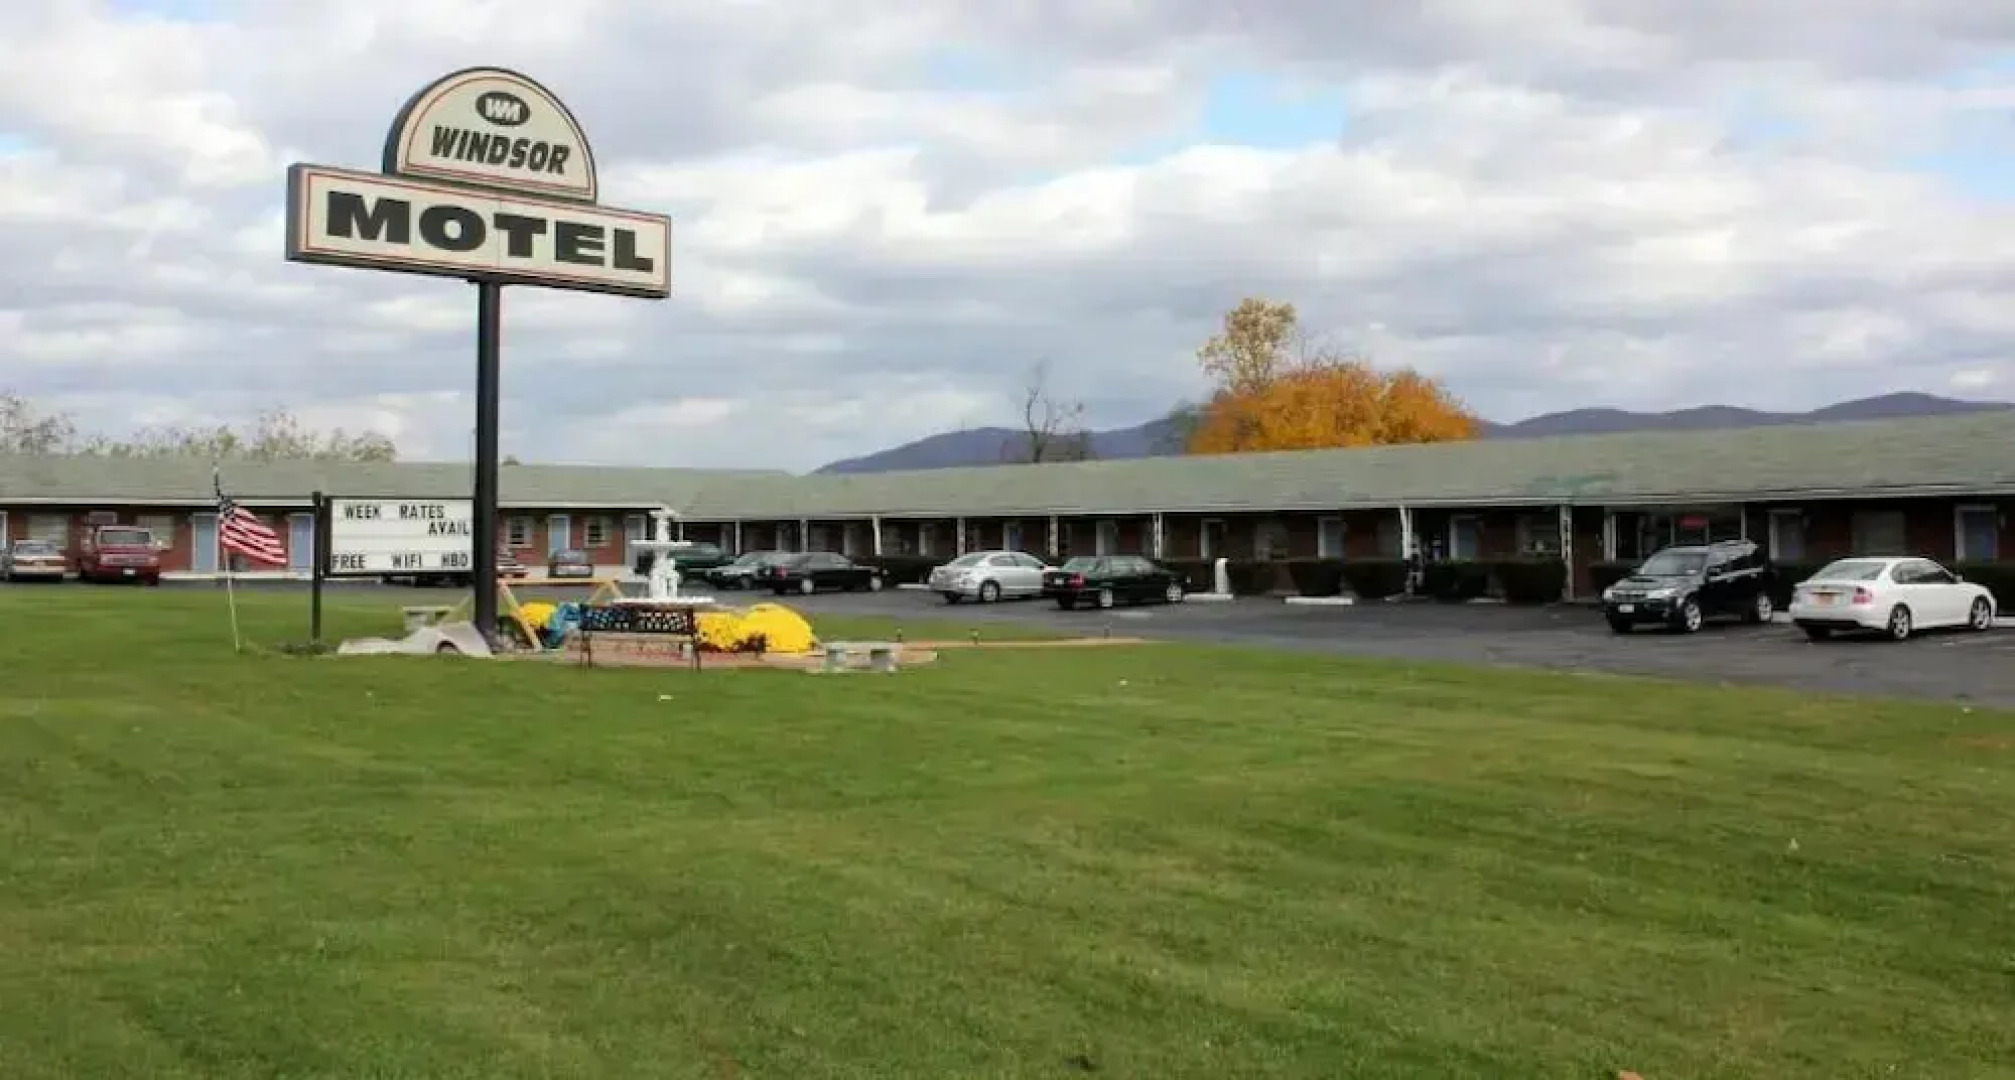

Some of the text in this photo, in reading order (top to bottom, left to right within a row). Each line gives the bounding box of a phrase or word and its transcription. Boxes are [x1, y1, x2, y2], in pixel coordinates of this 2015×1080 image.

[484, 97, 522, 119] WM
[430, 126, 571, 174] WINDSOR
[327, 190, 654, 273] MOTEL
[344, 505, 444, 520] WEEK RATES
[428, 522, 470, 536] AVAIL
[331, 553, 468, 569] FREE WIFI HBO
